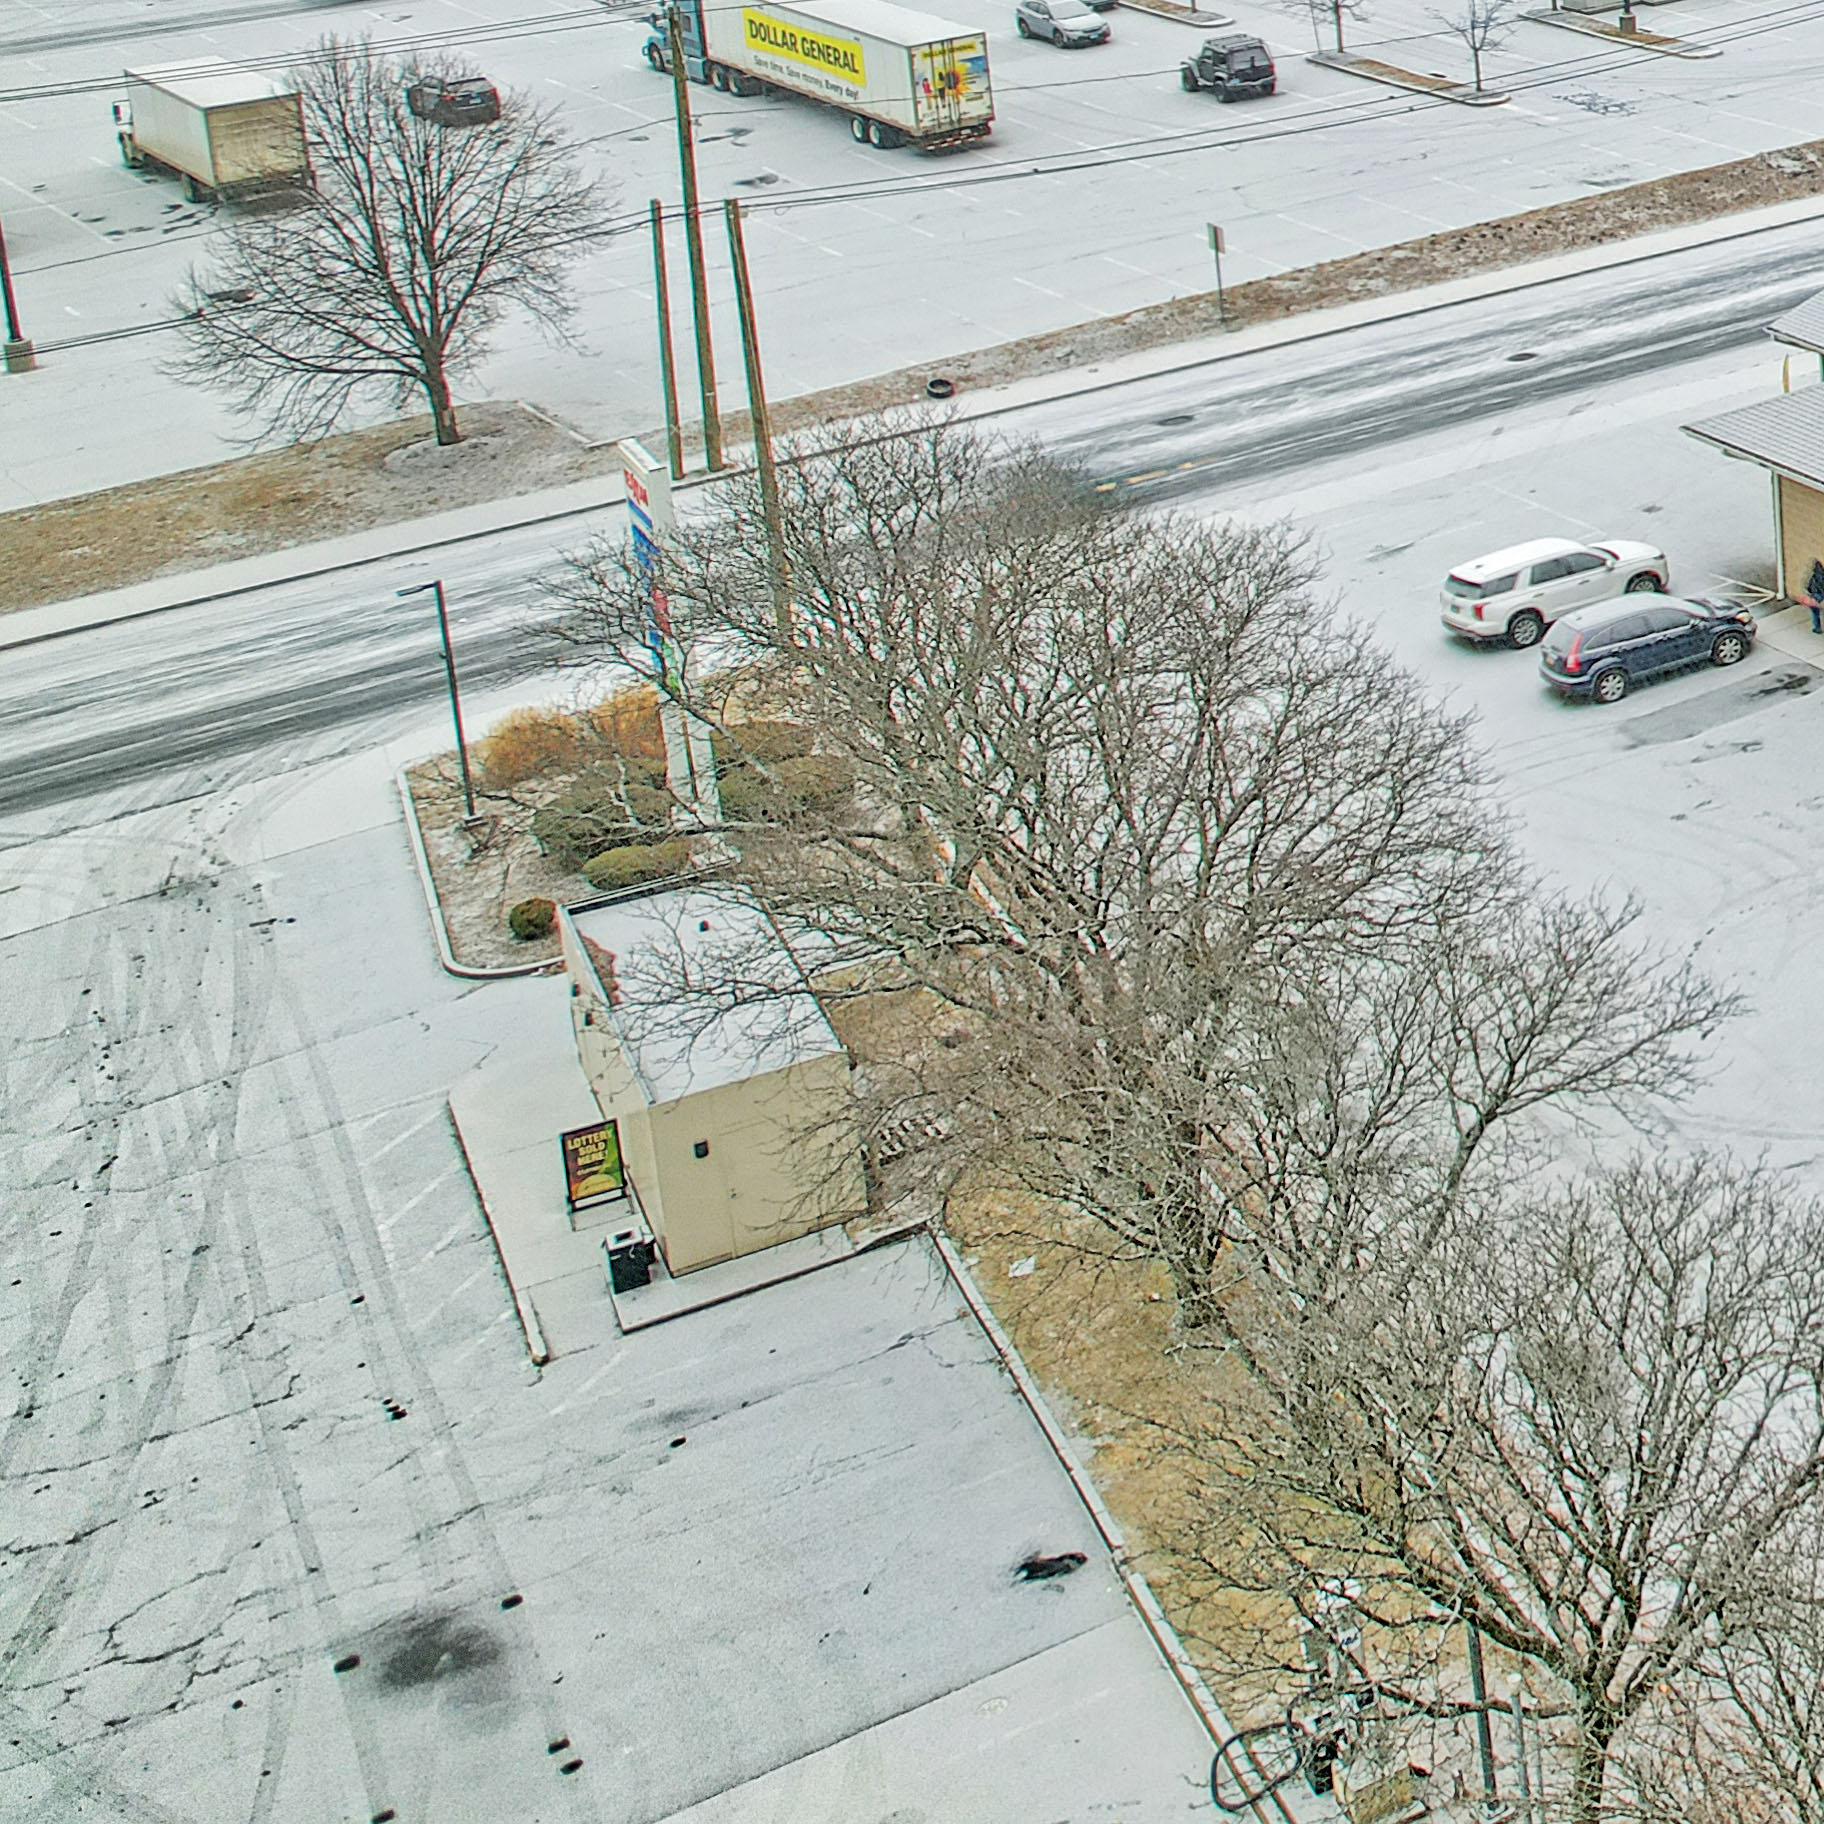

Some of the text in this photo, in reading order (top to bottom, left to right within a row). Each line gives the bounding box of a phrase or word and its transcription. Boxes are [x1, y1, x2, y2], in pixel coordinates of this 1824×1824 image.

[748, 18, 859, 74] DOLLAR GENERAL
[824, 79, 843, 96] Every
[567, 1128, 614, 1151] LOTTERY
[577, 1149, 609, 1167] HERE!
[578, 1141, 606, 1157] SOLD
